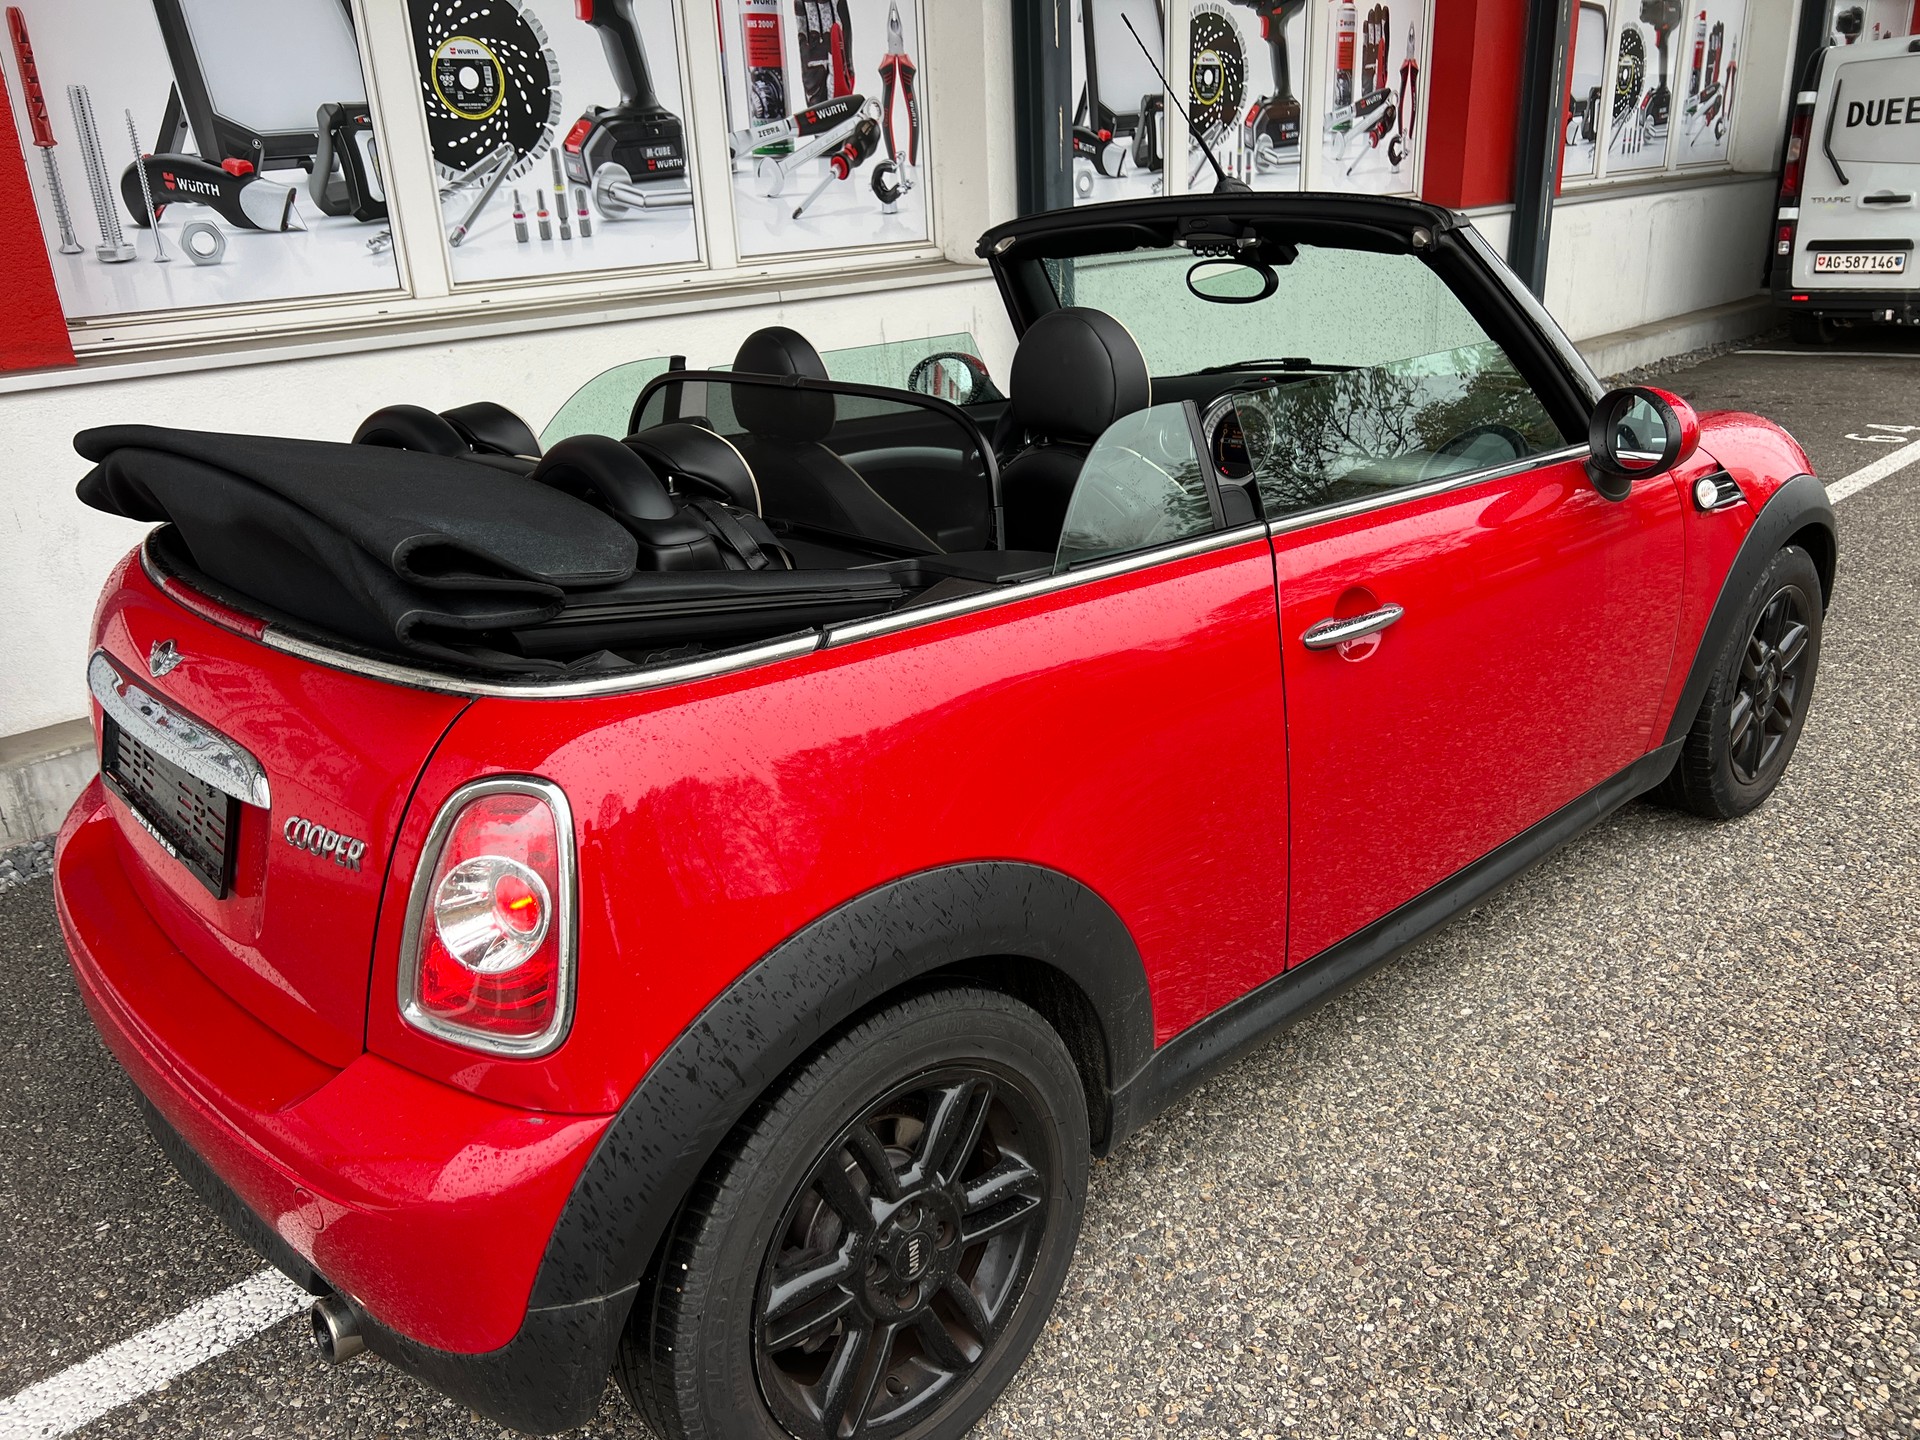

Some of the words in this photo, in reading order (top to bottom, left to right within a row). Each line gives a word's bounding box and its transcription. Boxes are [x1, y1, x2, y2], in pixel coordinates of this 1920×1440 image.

[758, 126, 780, 138] ZEBRA
[176, 177, 220, 197] WÜRTH
[1811, 196, 1851, 204] TRAFIC
[283, 815, 365, 873] COOPER
[908, 1238, 920, 1275] MINI
